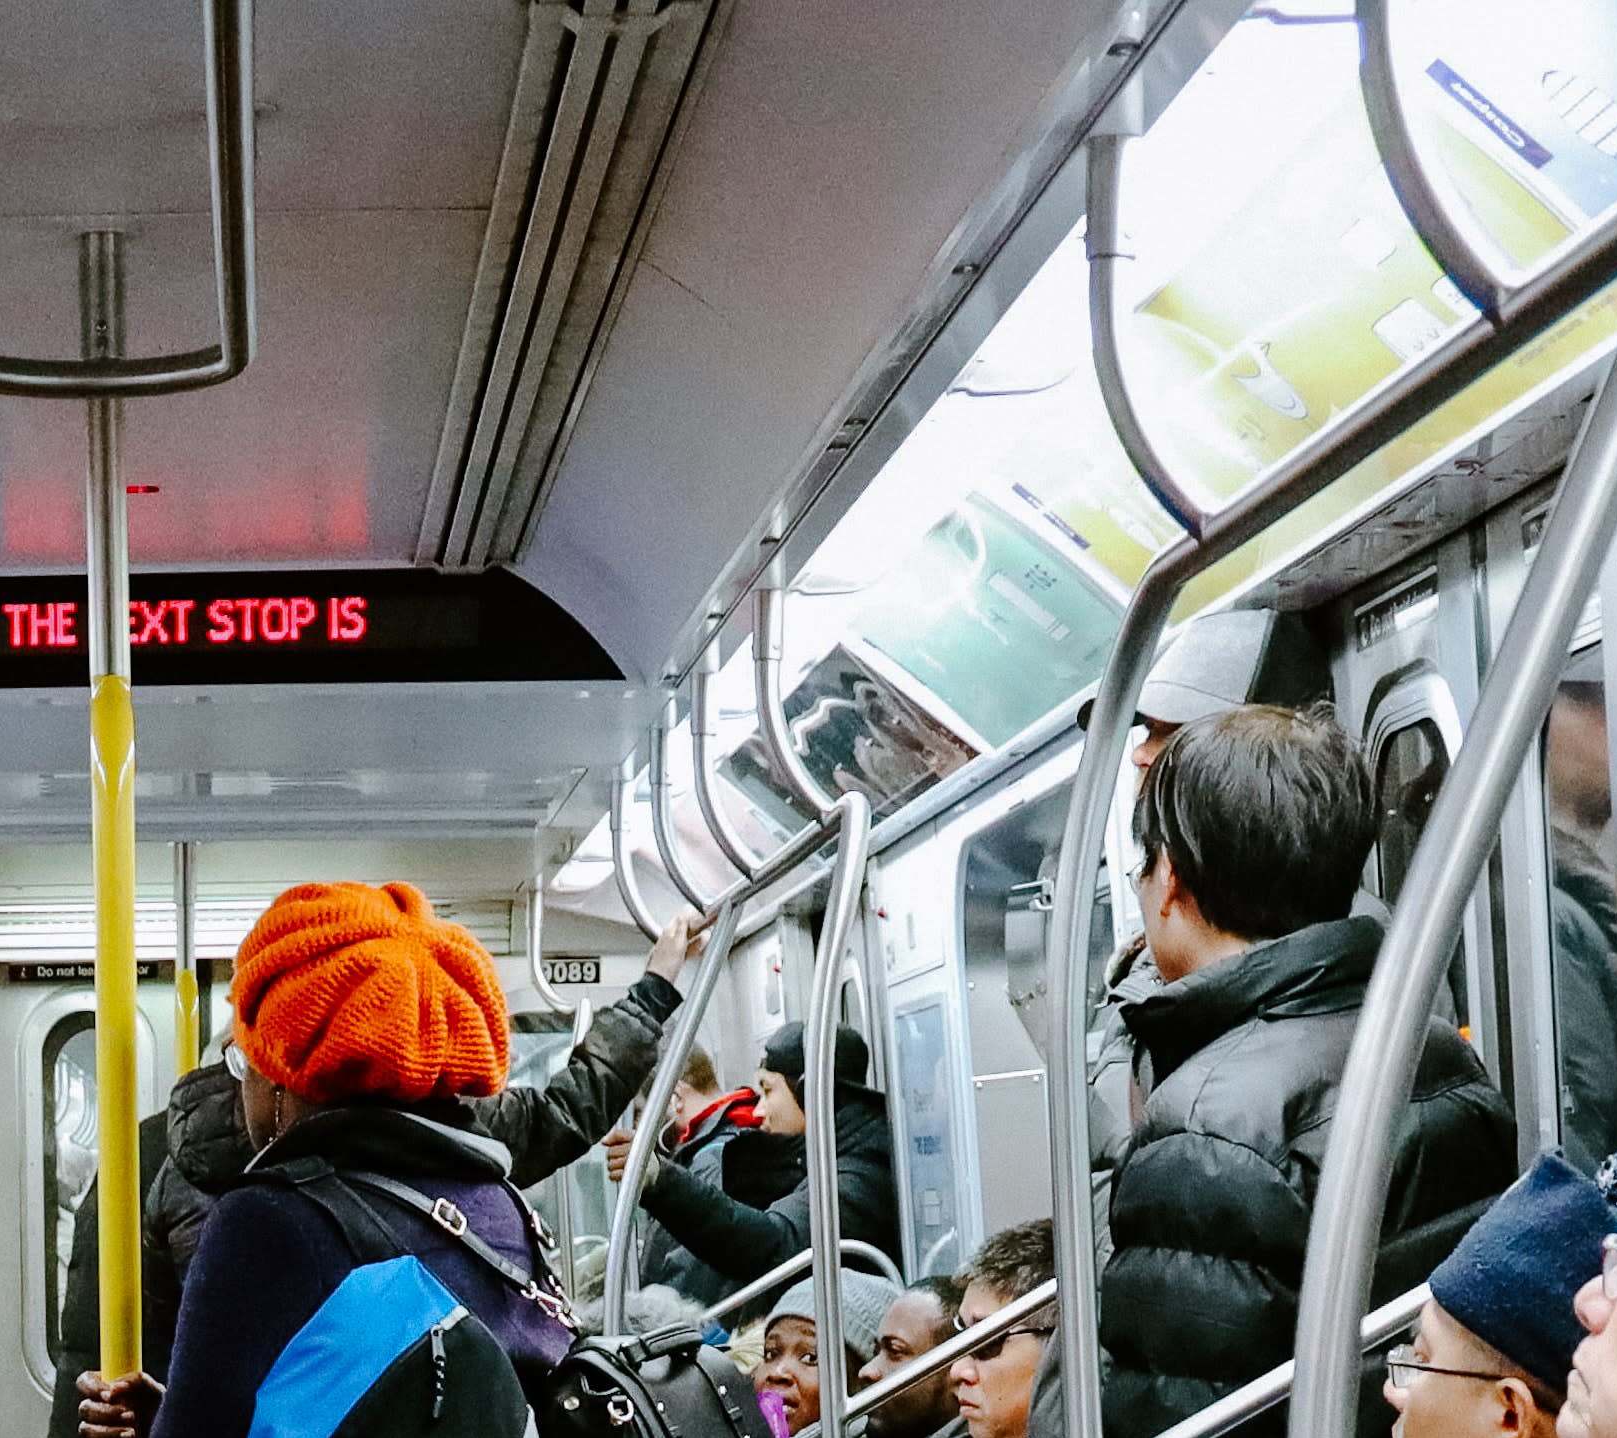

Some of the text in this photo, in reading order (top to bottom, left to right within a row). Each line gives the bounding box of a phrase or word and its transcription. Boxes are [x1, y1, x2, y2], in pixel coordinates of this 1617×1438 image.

[2, 603, 77, 646] THE
[129, 600, 195, 644] EXT
[207, 598, 316, 643] STOP
[328, 597, 366, 641] IS
